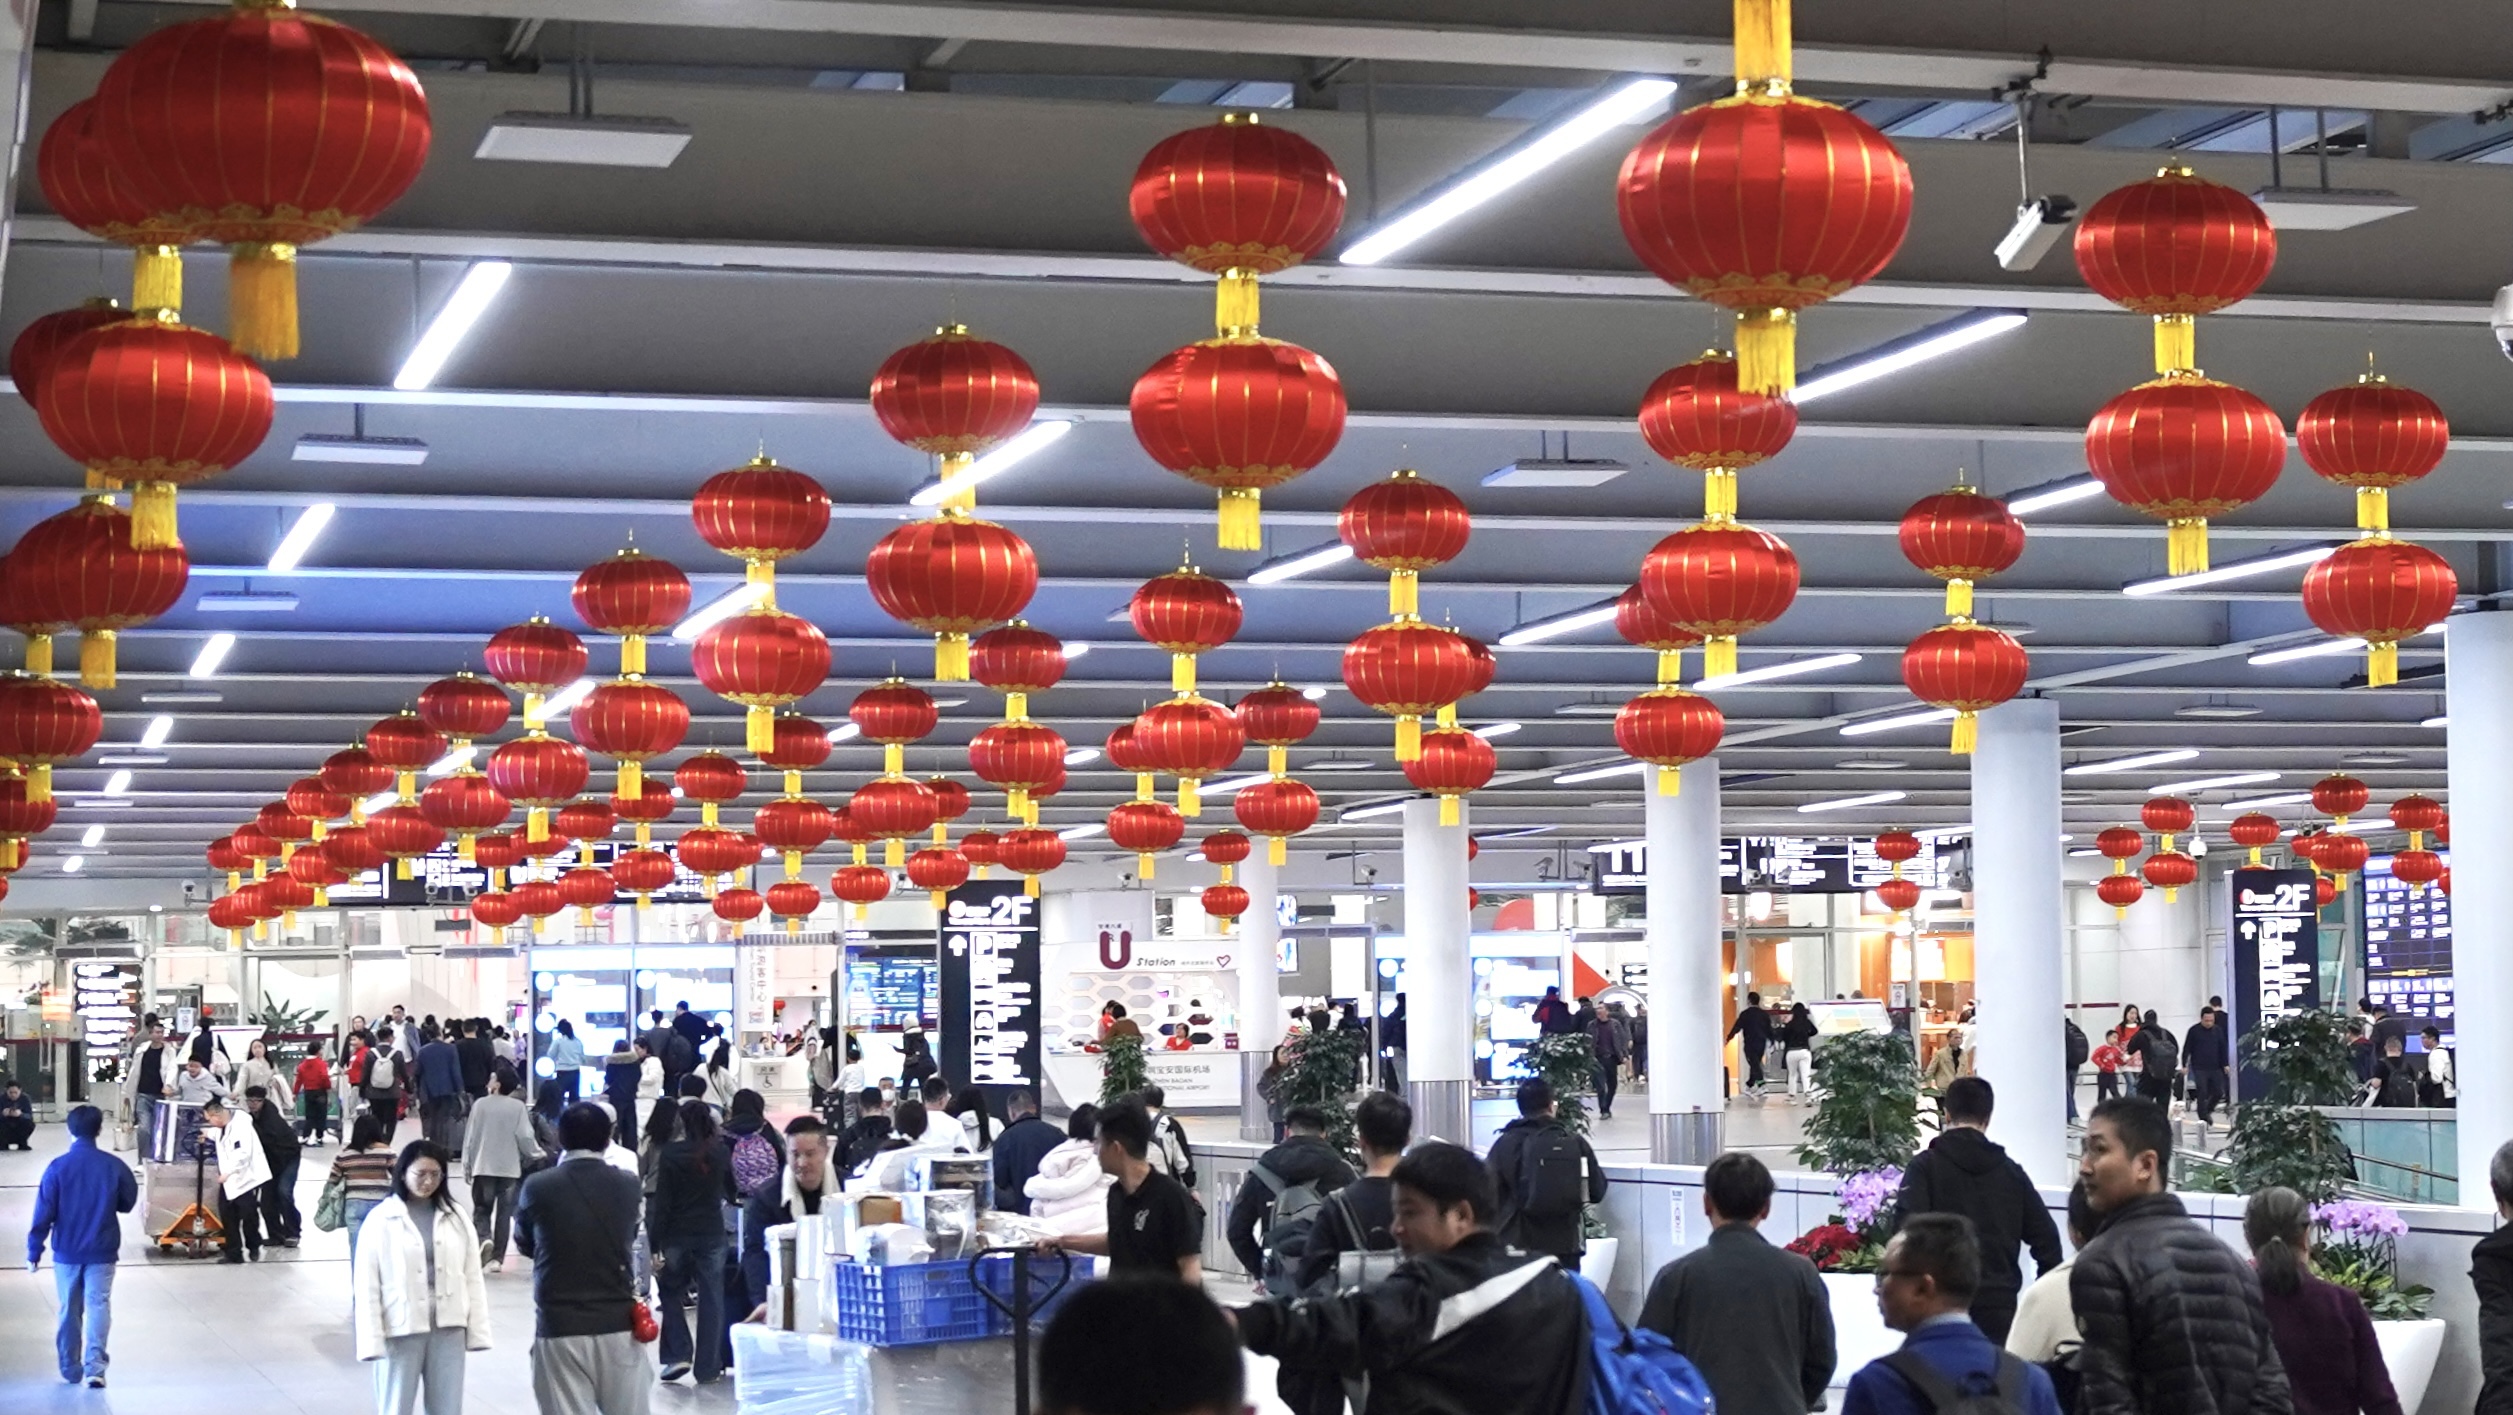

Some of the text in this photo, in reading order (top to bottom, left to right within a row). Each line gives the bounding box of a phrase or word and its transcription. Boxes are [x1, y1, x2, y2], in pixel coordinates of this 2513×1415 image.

[990, 895, 1034, 926] 2F
[2274, 883, 2311, 911] 2F
[1099, 930, 1176, 970] U Station
[1147, 1065, 1211, 1075] 圳宝安国际机场
